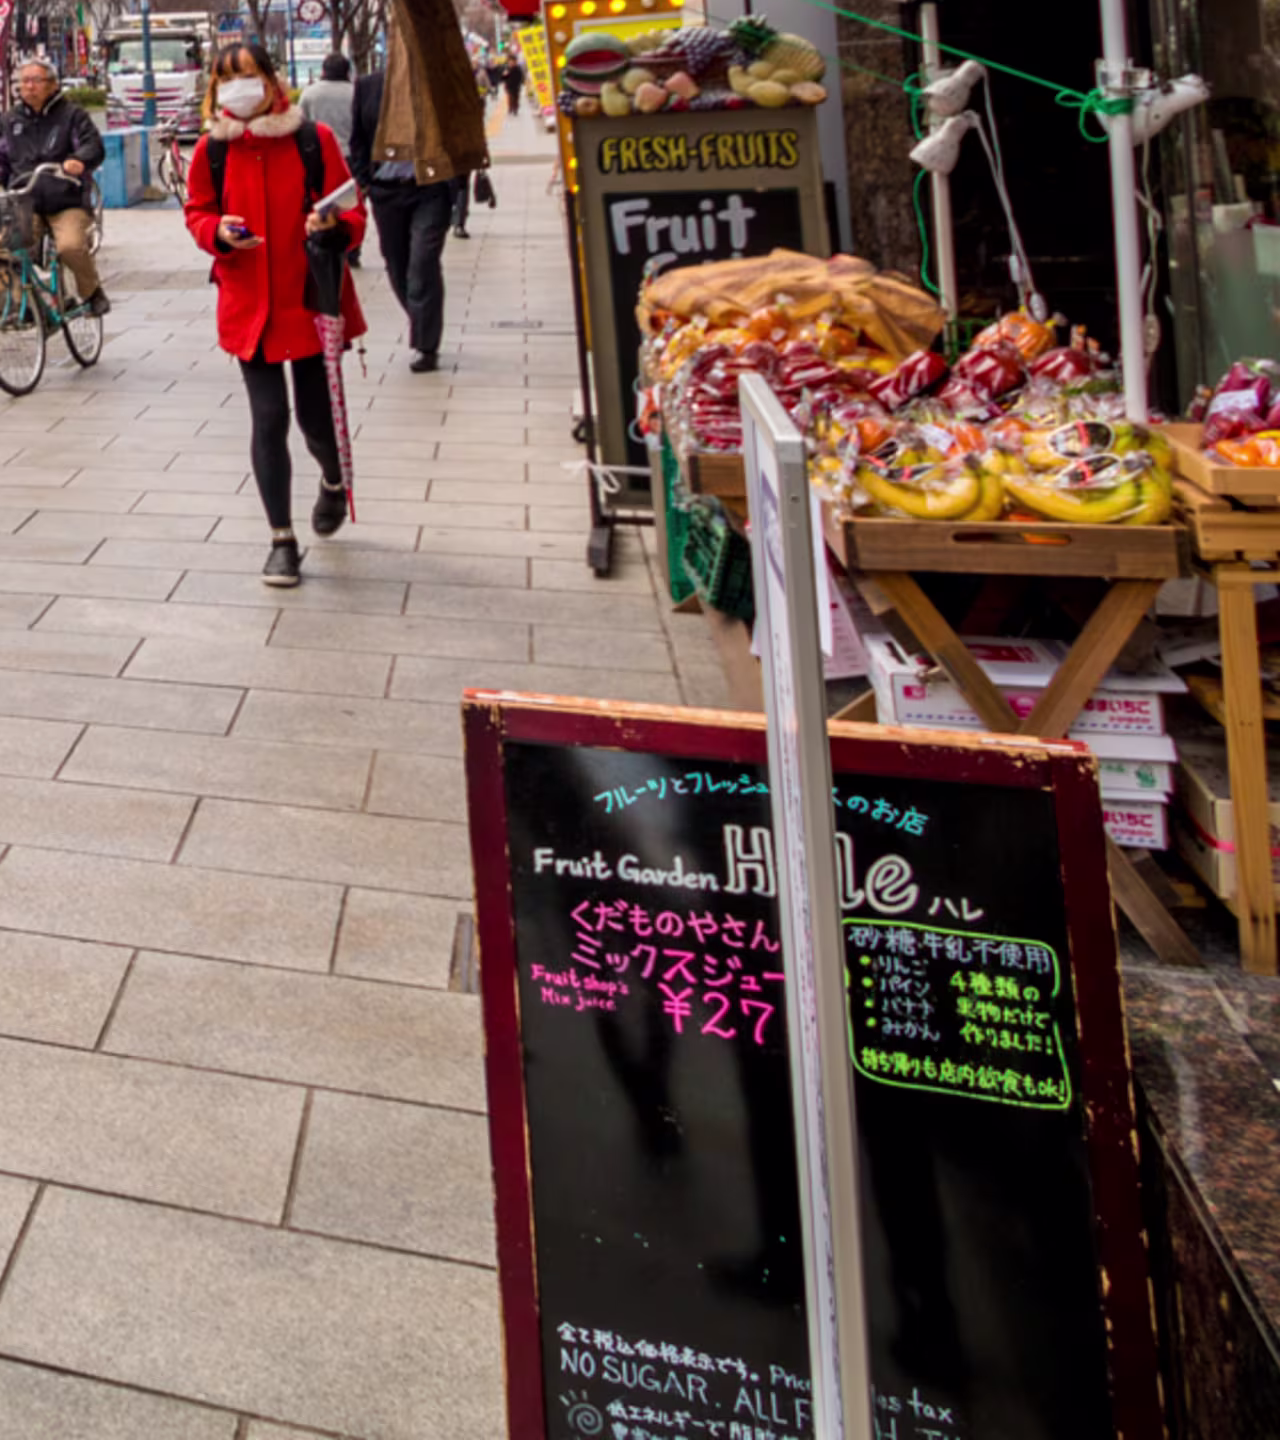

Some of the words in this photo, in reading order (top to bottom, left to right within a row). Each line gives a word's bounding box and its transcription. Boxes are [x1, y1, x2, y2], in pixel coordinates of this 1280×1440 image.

[599, 129, 799, 174] FRESH-FRUITS
[609, 194, 756, 255] Fruit
[532, 848, 614, 881] Fruit
[617, 855, 720, 892] Garden
[723, 823, 919, 914] Hle
[928, 895, 984, 922] ハレ
[531, 964, 580, 989] Fruit
[571, 931, 785, 992] ミックスジュー
[878, 955, 929, 975] りんご
[574, 990, 617, 1013] juice
[880, 975, 931, 998] パイン
[659, 982, 775, 1045] ¥27
[881, 997, 935, 1020] バナナ
[881, 1016, 940, 1041] みかん
[561, 1347, 596, 1378] NO
[734, 1386, 788, 1425] ALL
[907, 1386, 954, 1425] tax
